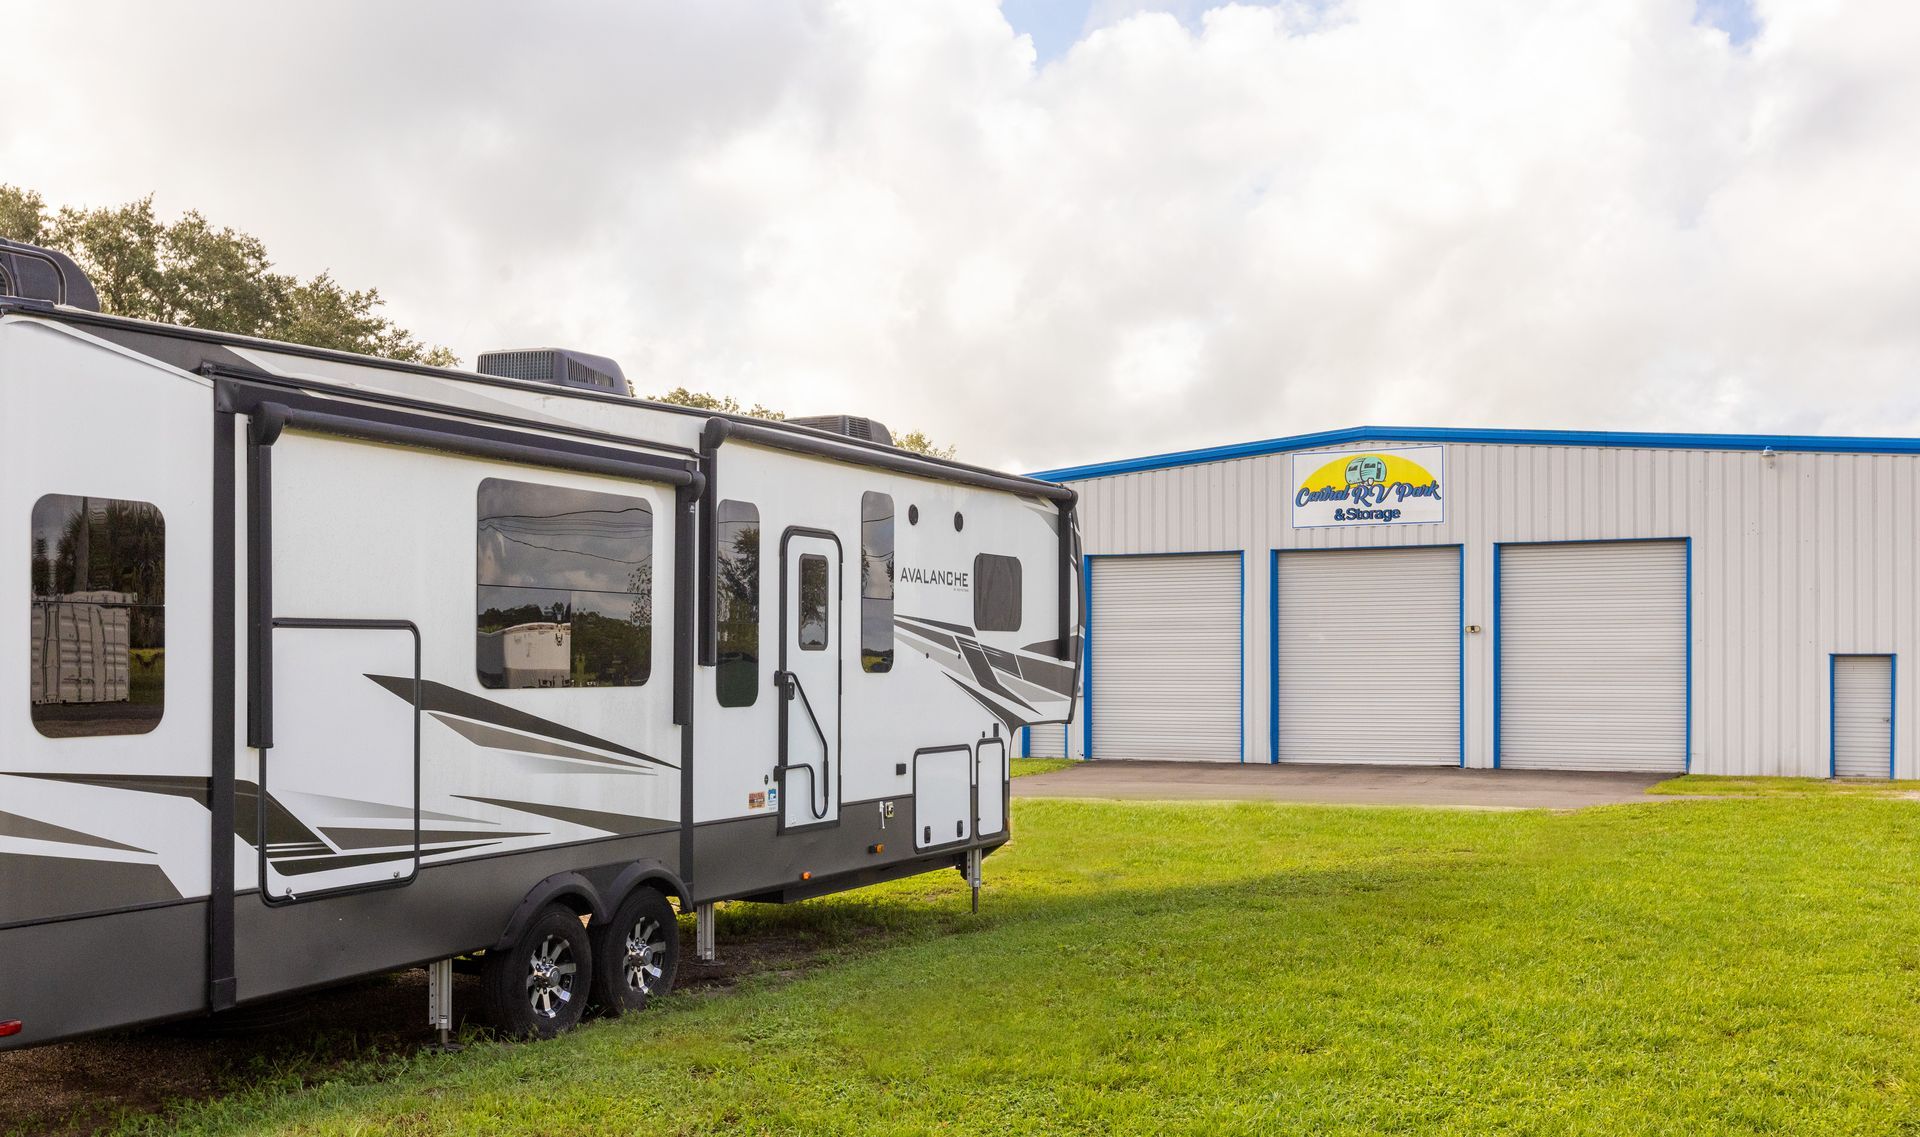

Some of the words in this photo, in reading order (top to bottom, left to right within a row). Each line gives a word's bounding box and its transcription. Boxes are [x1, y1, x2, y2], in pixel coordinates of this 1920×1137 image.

[1295, 486, 1350, 507] Central
[1351, 483, 1398, 507] RV
[1396, 480, 1442, 503] Park
[900, 567, 969, 588] AVALANCHE
